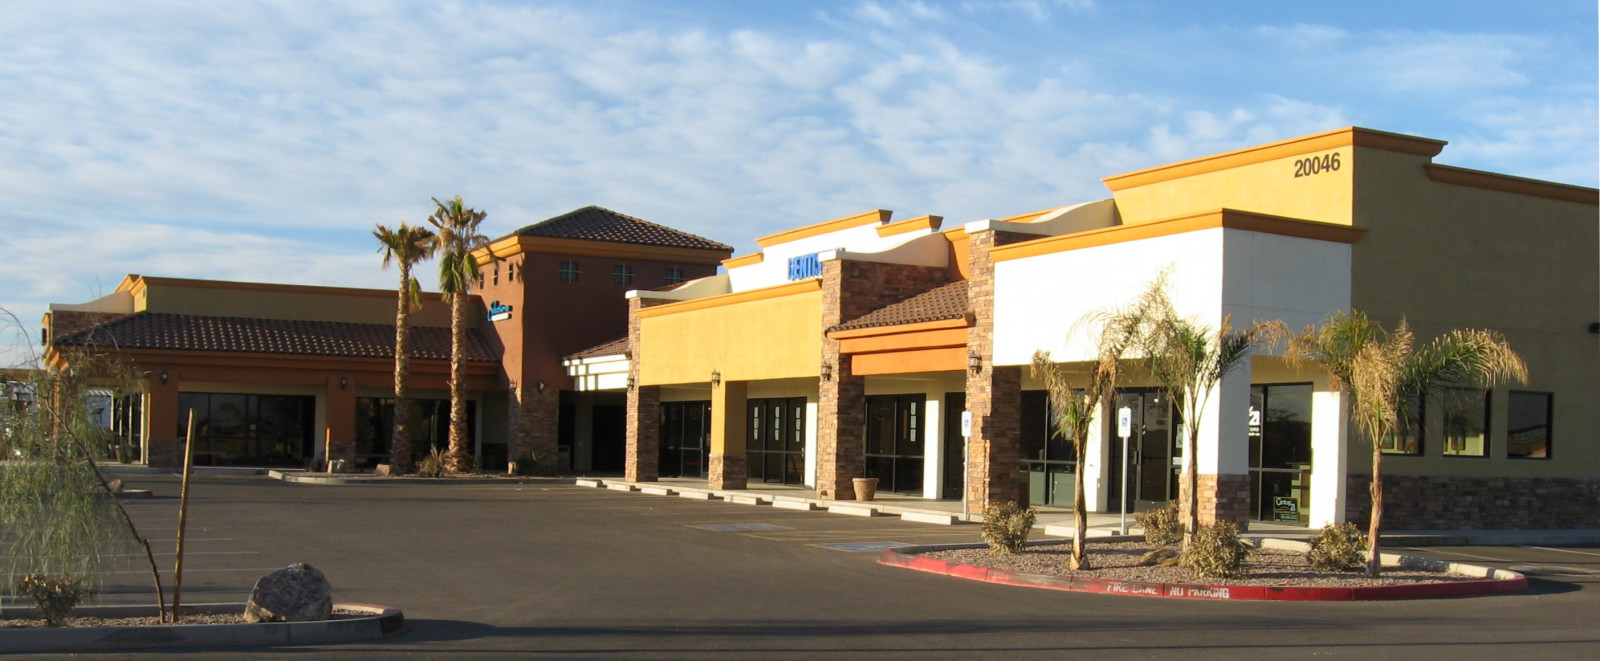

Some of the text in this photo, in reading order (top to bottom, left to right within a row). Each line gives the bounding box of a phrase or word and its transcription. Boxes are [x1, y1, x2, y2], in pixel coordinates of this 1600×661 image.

[1294, 152, 1341, 178] 20046
[787, 253, 824, 281] DENTIS
[1107, 582, 1128, 593] FIRE
[1188, 587, 1230, 599] PARKING
